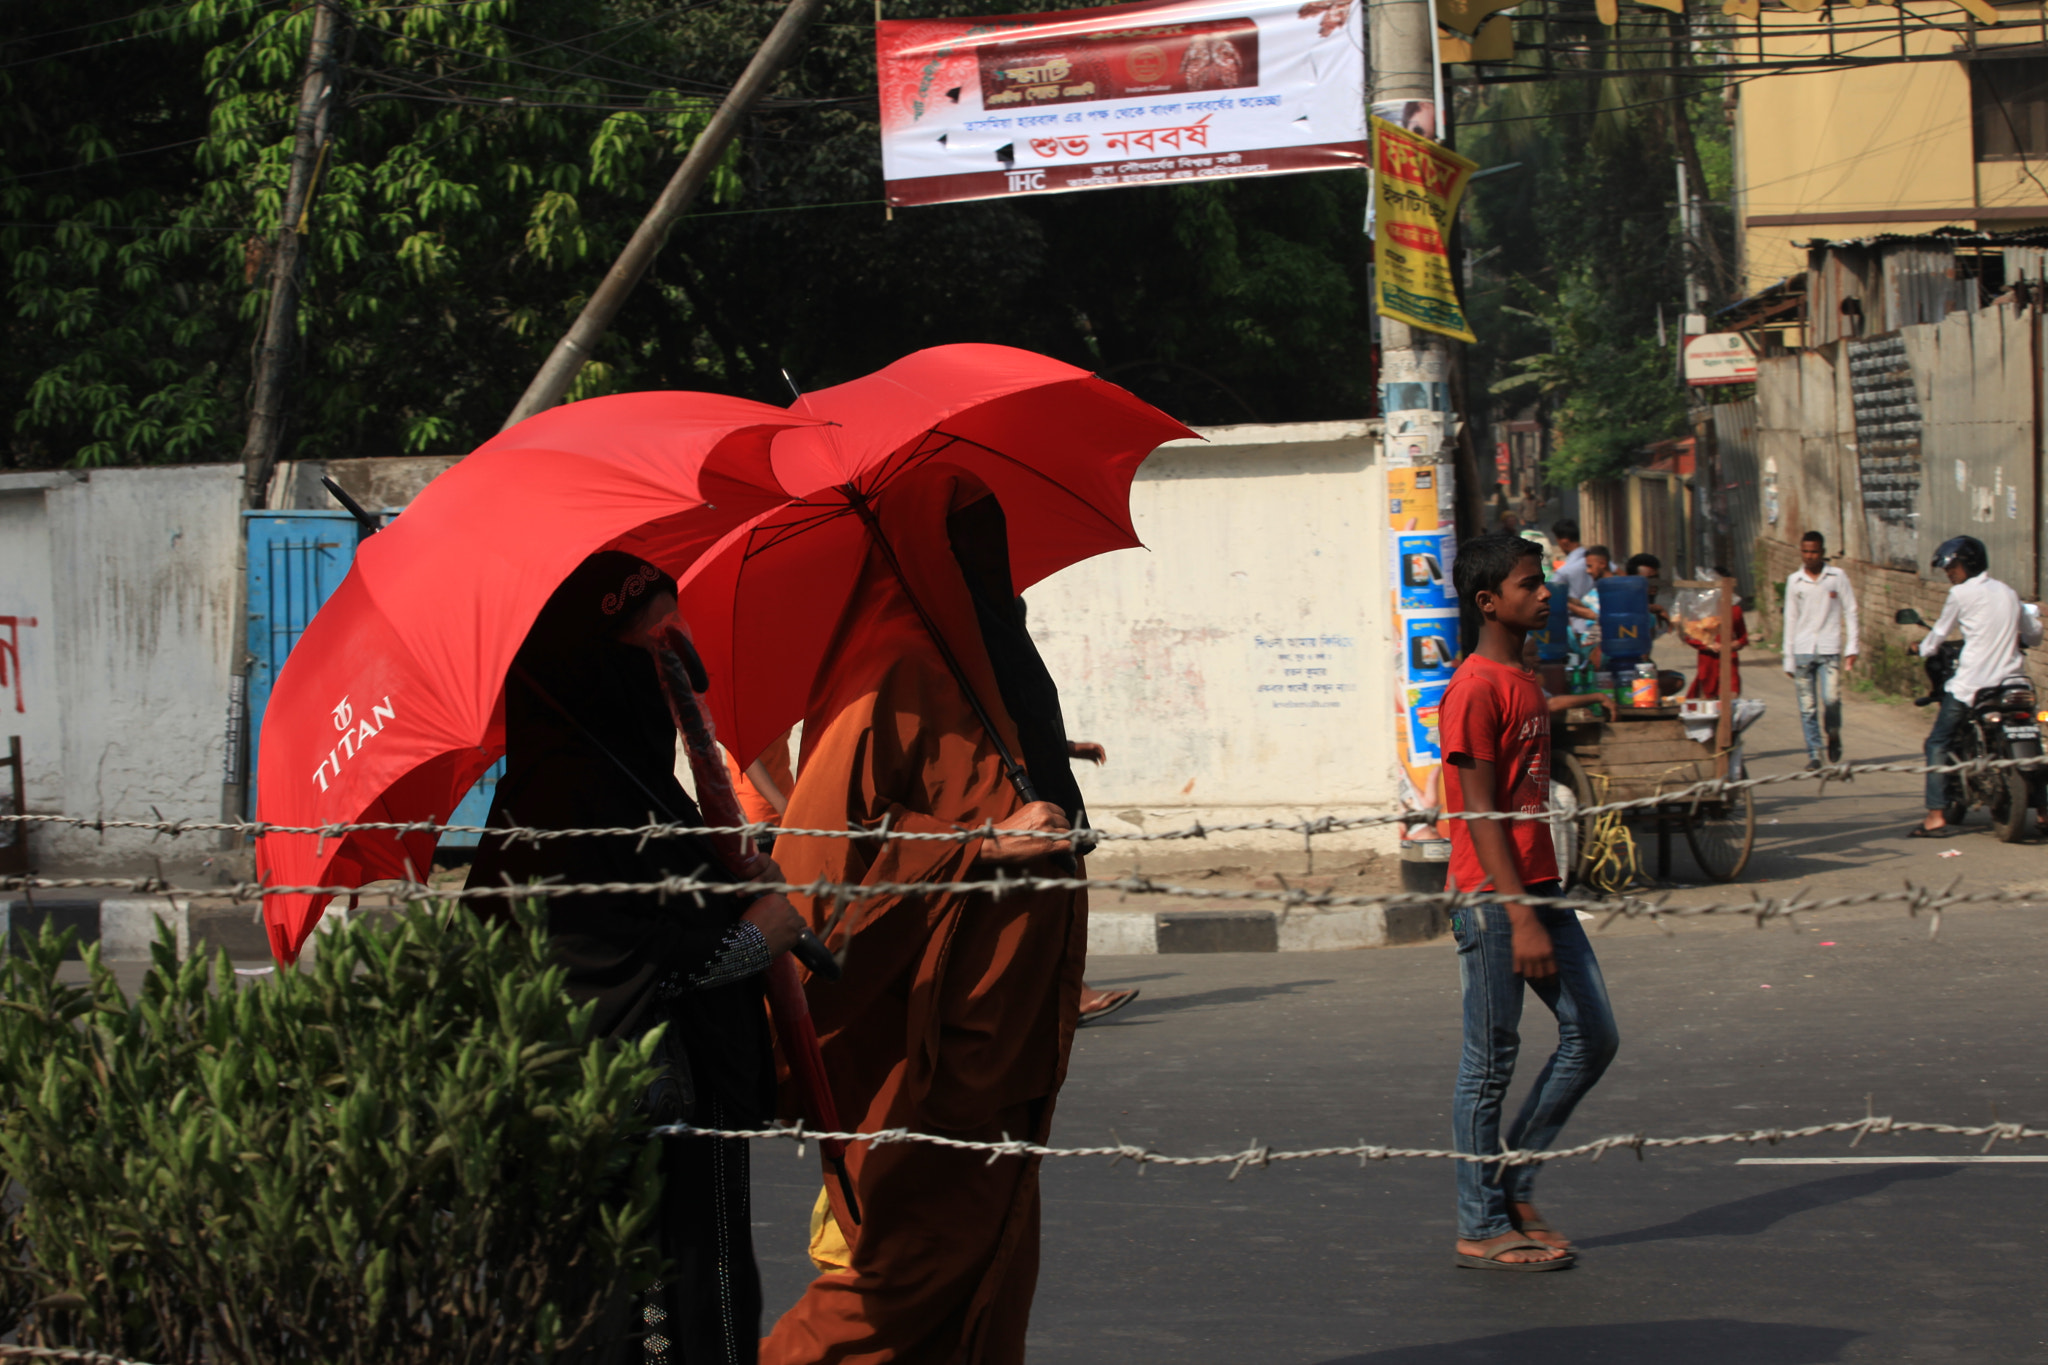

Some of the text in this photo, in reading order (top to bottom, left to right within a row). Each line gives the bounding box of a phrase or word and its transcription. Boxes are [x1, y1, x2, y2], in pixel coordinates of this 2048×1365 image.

[1063, 112, 1083, 123] এর
[1114, 106, 1145, 119] থেকে
[1150, 103, 1182, 116] বাংলা
[1028, 113, 1215, 158] শুভ নববর্ষ
[1004, 169, 1046, 192] IHC
[1618, 624, 1639, 639] N
[312, 695, 397, 794] TITAN
